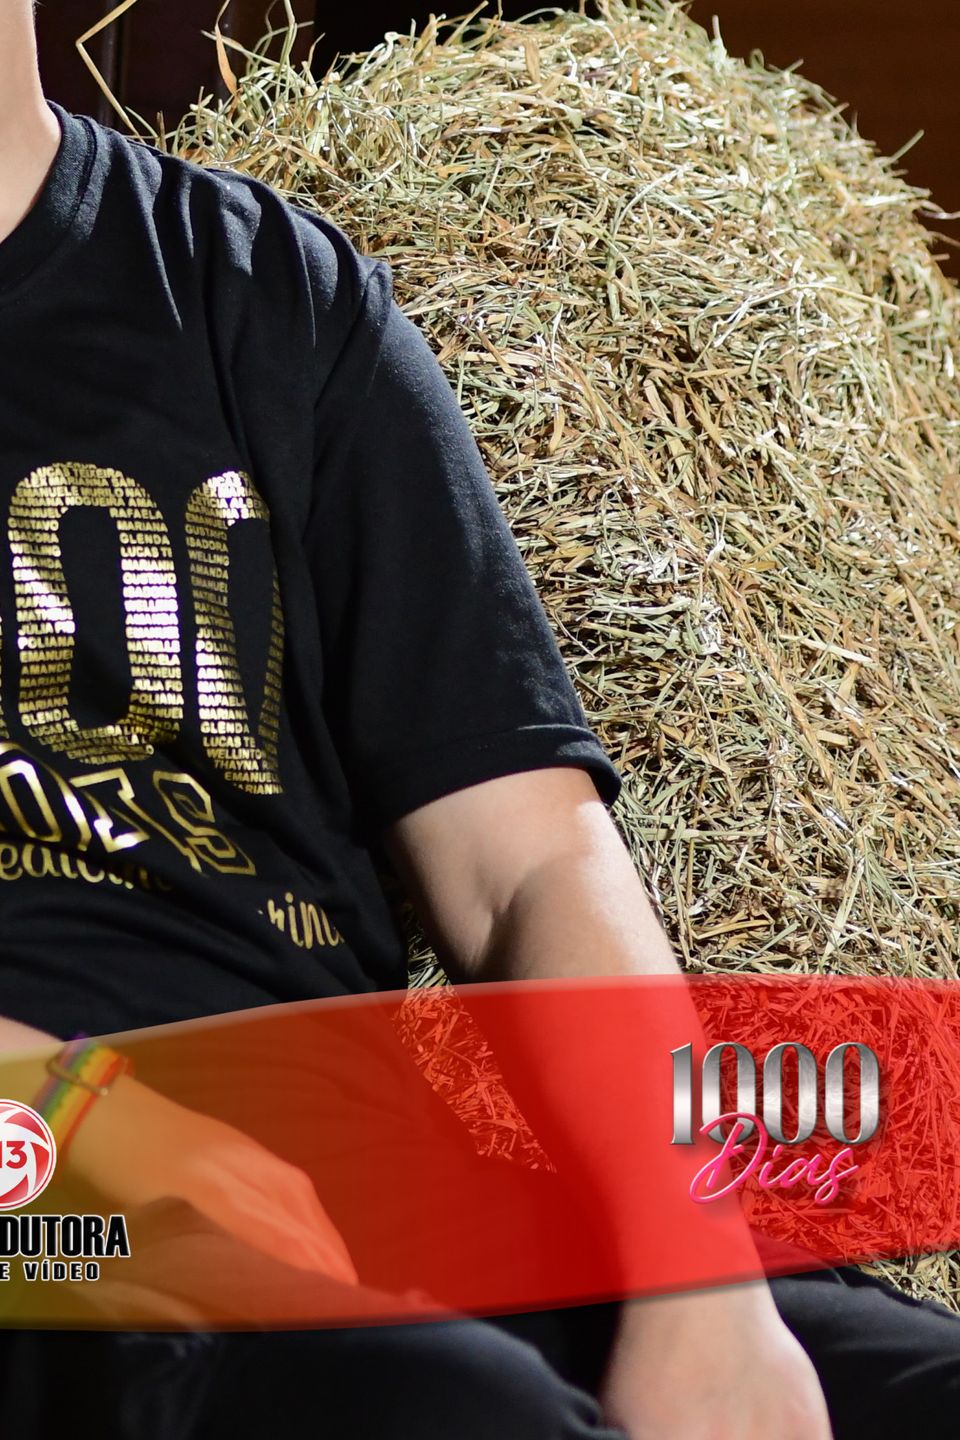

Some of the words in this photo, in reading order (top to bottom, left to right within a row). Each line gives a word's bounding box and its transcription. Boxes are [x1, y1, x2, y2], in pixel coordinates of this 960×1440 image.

[110, 507, 163, 520] RAFAELA
[7, 517, 59, 531] GUSTAVO
[117, 520, 168, 532] MARIANA
[8, 530, 59, 543] ISADORA
[119, 532, 170, 545] GLENDA
[185, 537, 229, 552] ISADORA
[120, 546, 159, 558] LUCAS
[12, 556, 62, 569] AMANDA
[190, 563, 229, 580] AMANDA
[18, 622, 53, 636] JULIA
[18, 636, 75, 650] POLIANA
[129, 653, 181, 666] RAFAELA
[21, 663, 72, 675] AMANDA
[131, 666, 181, 679] MATHEUS
[20, 674, 70, 688] MARIANA
[132, 679, 164, 691] JULIA
[18, 697, 69, 713] MARIANA
[129, 693, 184, 705] POLIANA
[21, 709, 70, 726] GLENDA
[29, 723, 64, 737] LUCAS
[200, 721, 250, 734] GLENDA
[203, 736, 241, 748] LUCAS
[214, 760, 259, 770] THAYNA
